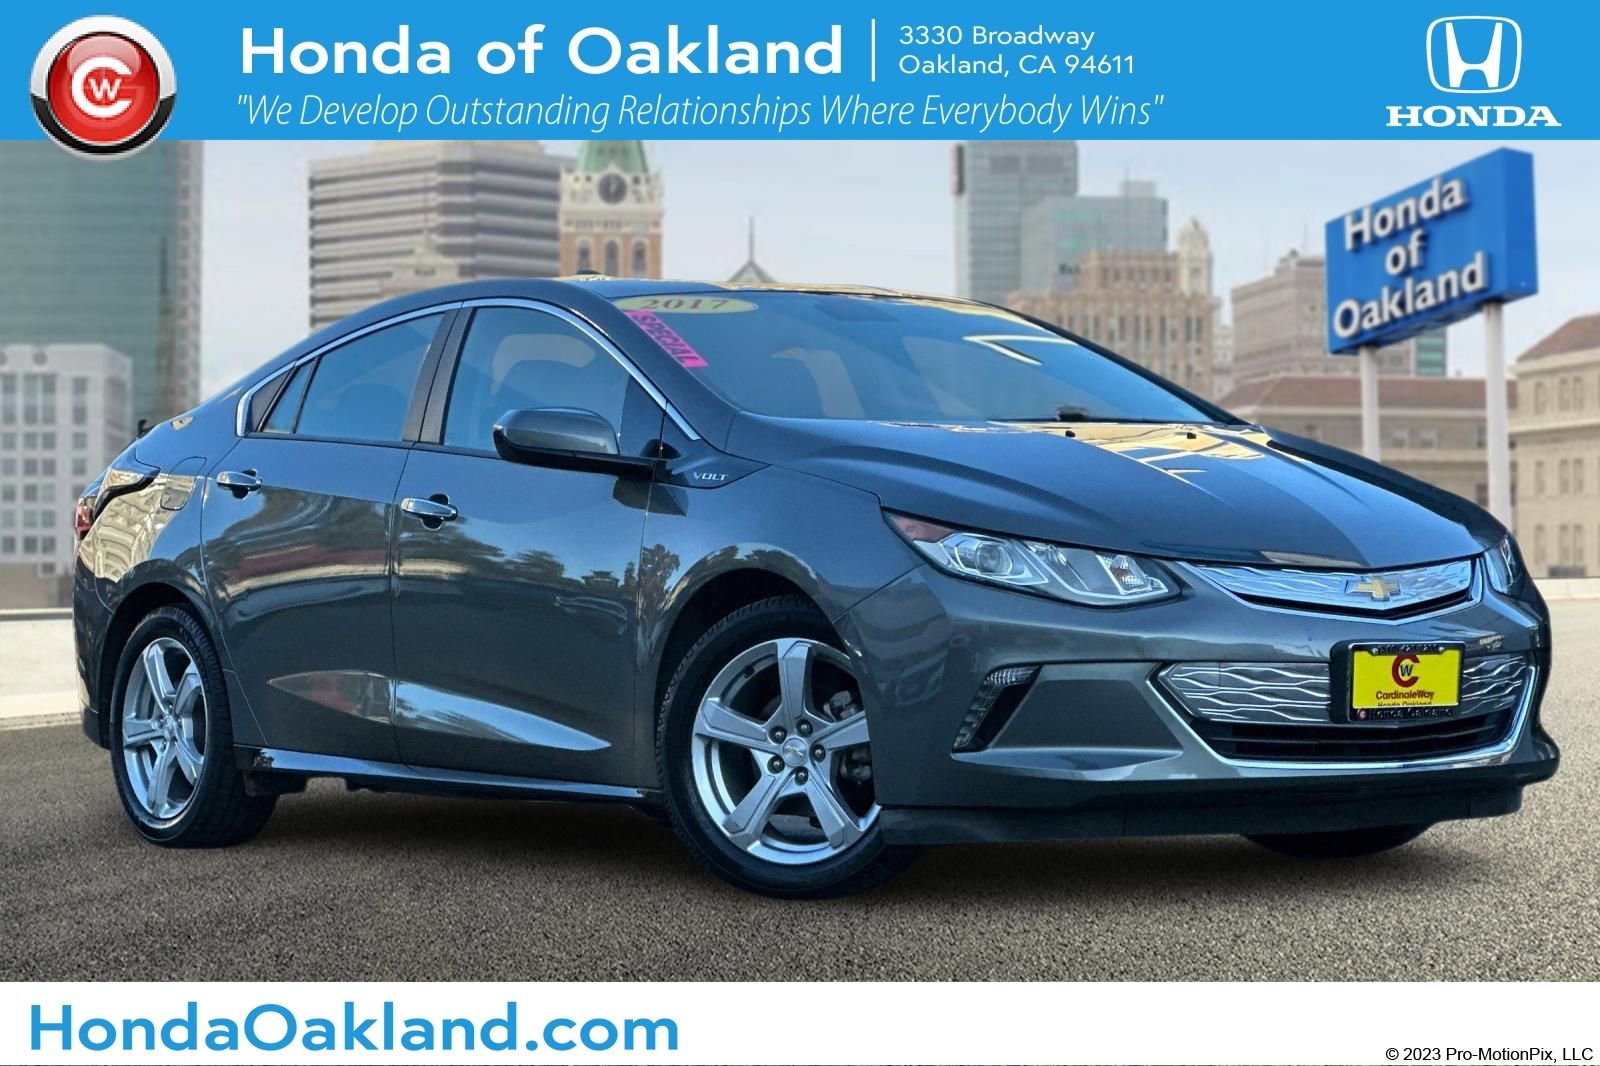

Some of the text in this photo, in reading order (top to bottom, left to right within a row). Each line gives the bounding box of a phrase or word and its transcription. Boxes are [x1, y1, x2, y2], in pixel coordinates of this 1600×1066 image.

[1344, 176, 1467, 251] Honda
[1385, 229, 1425, 276] of
[641, 298, 728, 310] 2017
[1333, 250, 1487, 338] Oakland
[630, 312, 700, 364] SPECIAL
[693, 471, 729, 481] VOLT
[1376, 690, 1434, 701] CardinaleWay
